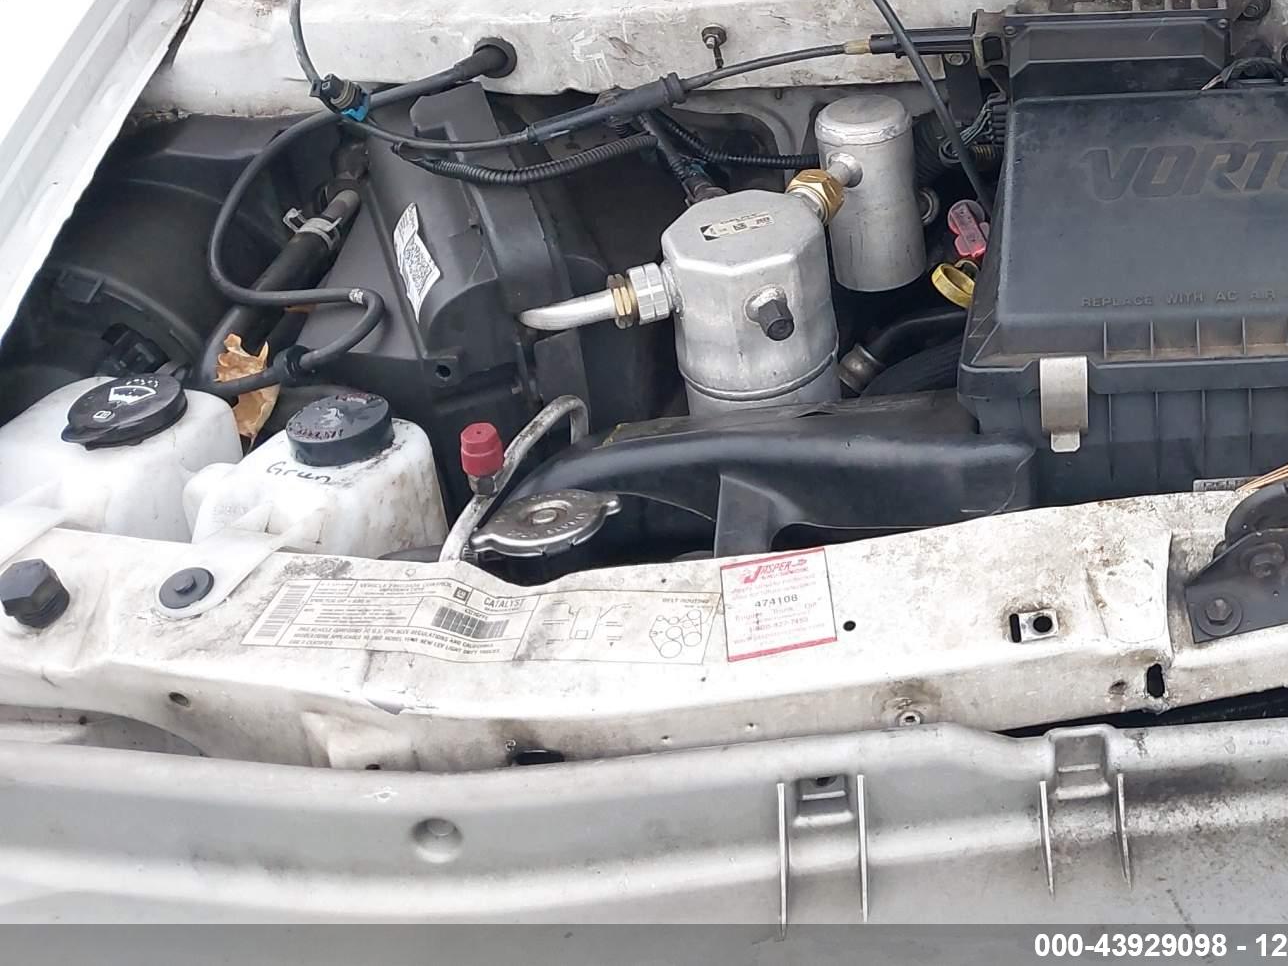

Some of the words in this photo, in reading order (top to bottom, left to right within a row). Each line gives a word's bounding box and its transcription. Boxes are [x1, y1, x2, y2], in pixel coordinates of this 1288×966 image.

[1081, 296, 1153, 308] REPLACE
[1167, 291, 1205, 306] WITH
[1216, 290, 1239, 303] AC
[483, 597, 526, 608] CATALYST
[754, 594, 799, 608] 474108
